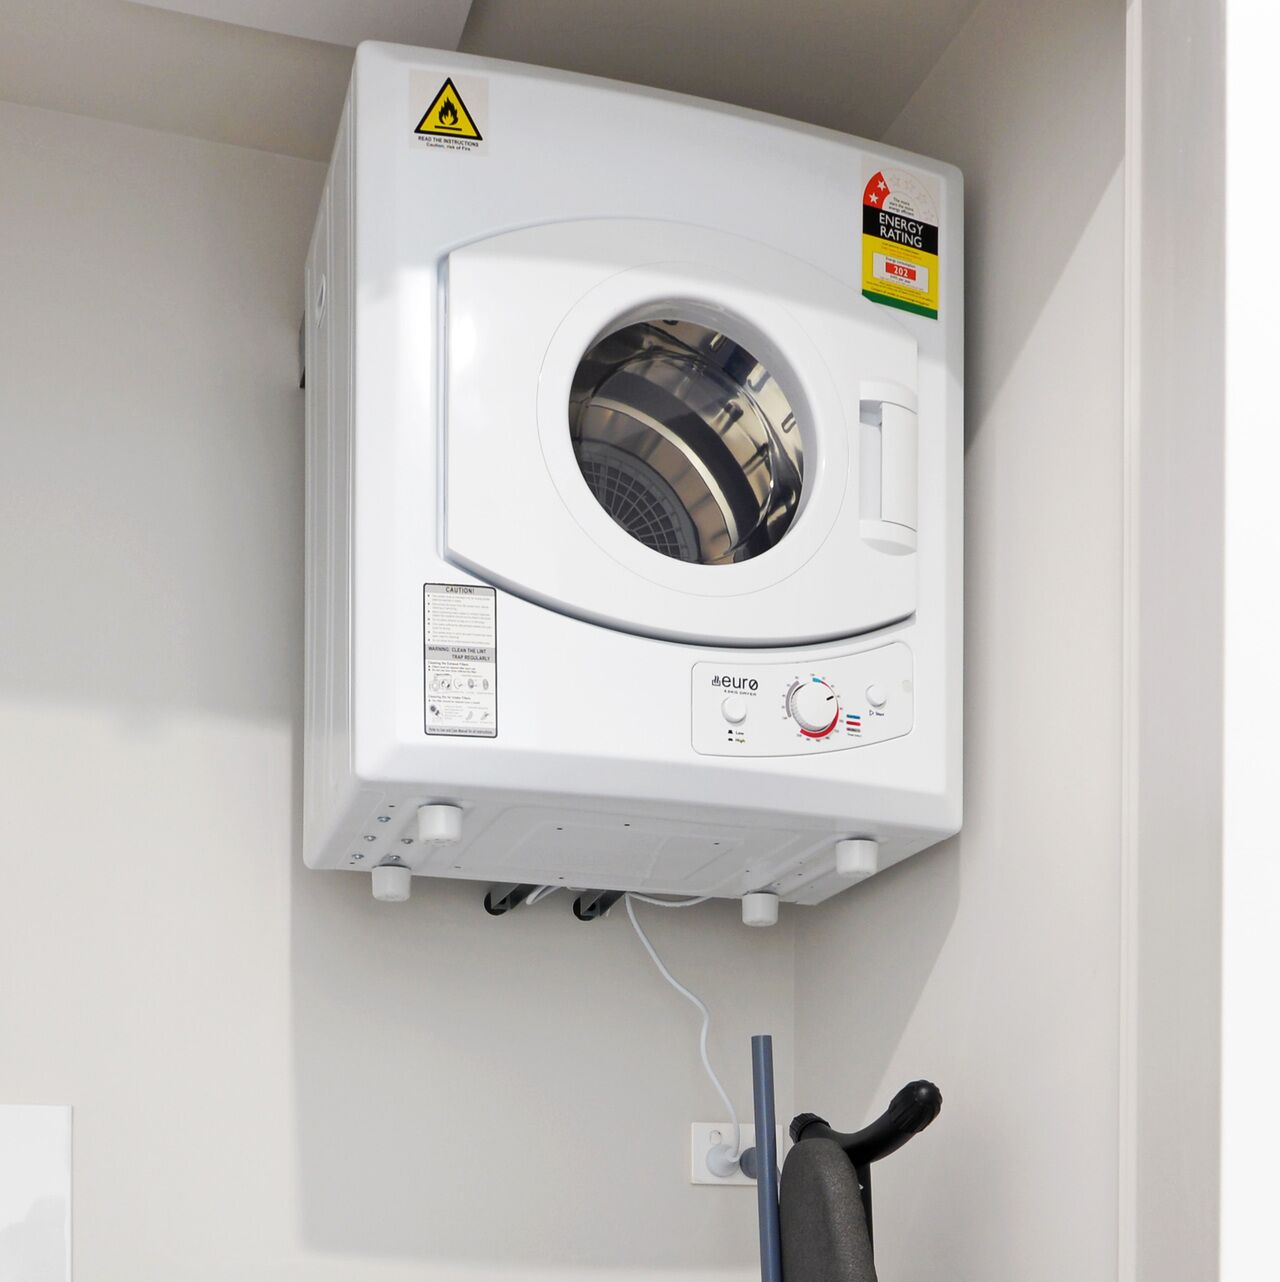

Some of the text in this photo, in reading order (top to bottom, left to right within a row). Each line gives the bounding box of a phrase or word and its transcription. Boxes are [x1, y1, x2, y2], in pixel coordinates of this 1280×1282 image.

[879, 213, 924, 236] ENERGY
[880, 226, 923, 248] RATING
[893, 266, 908, 277] 202
